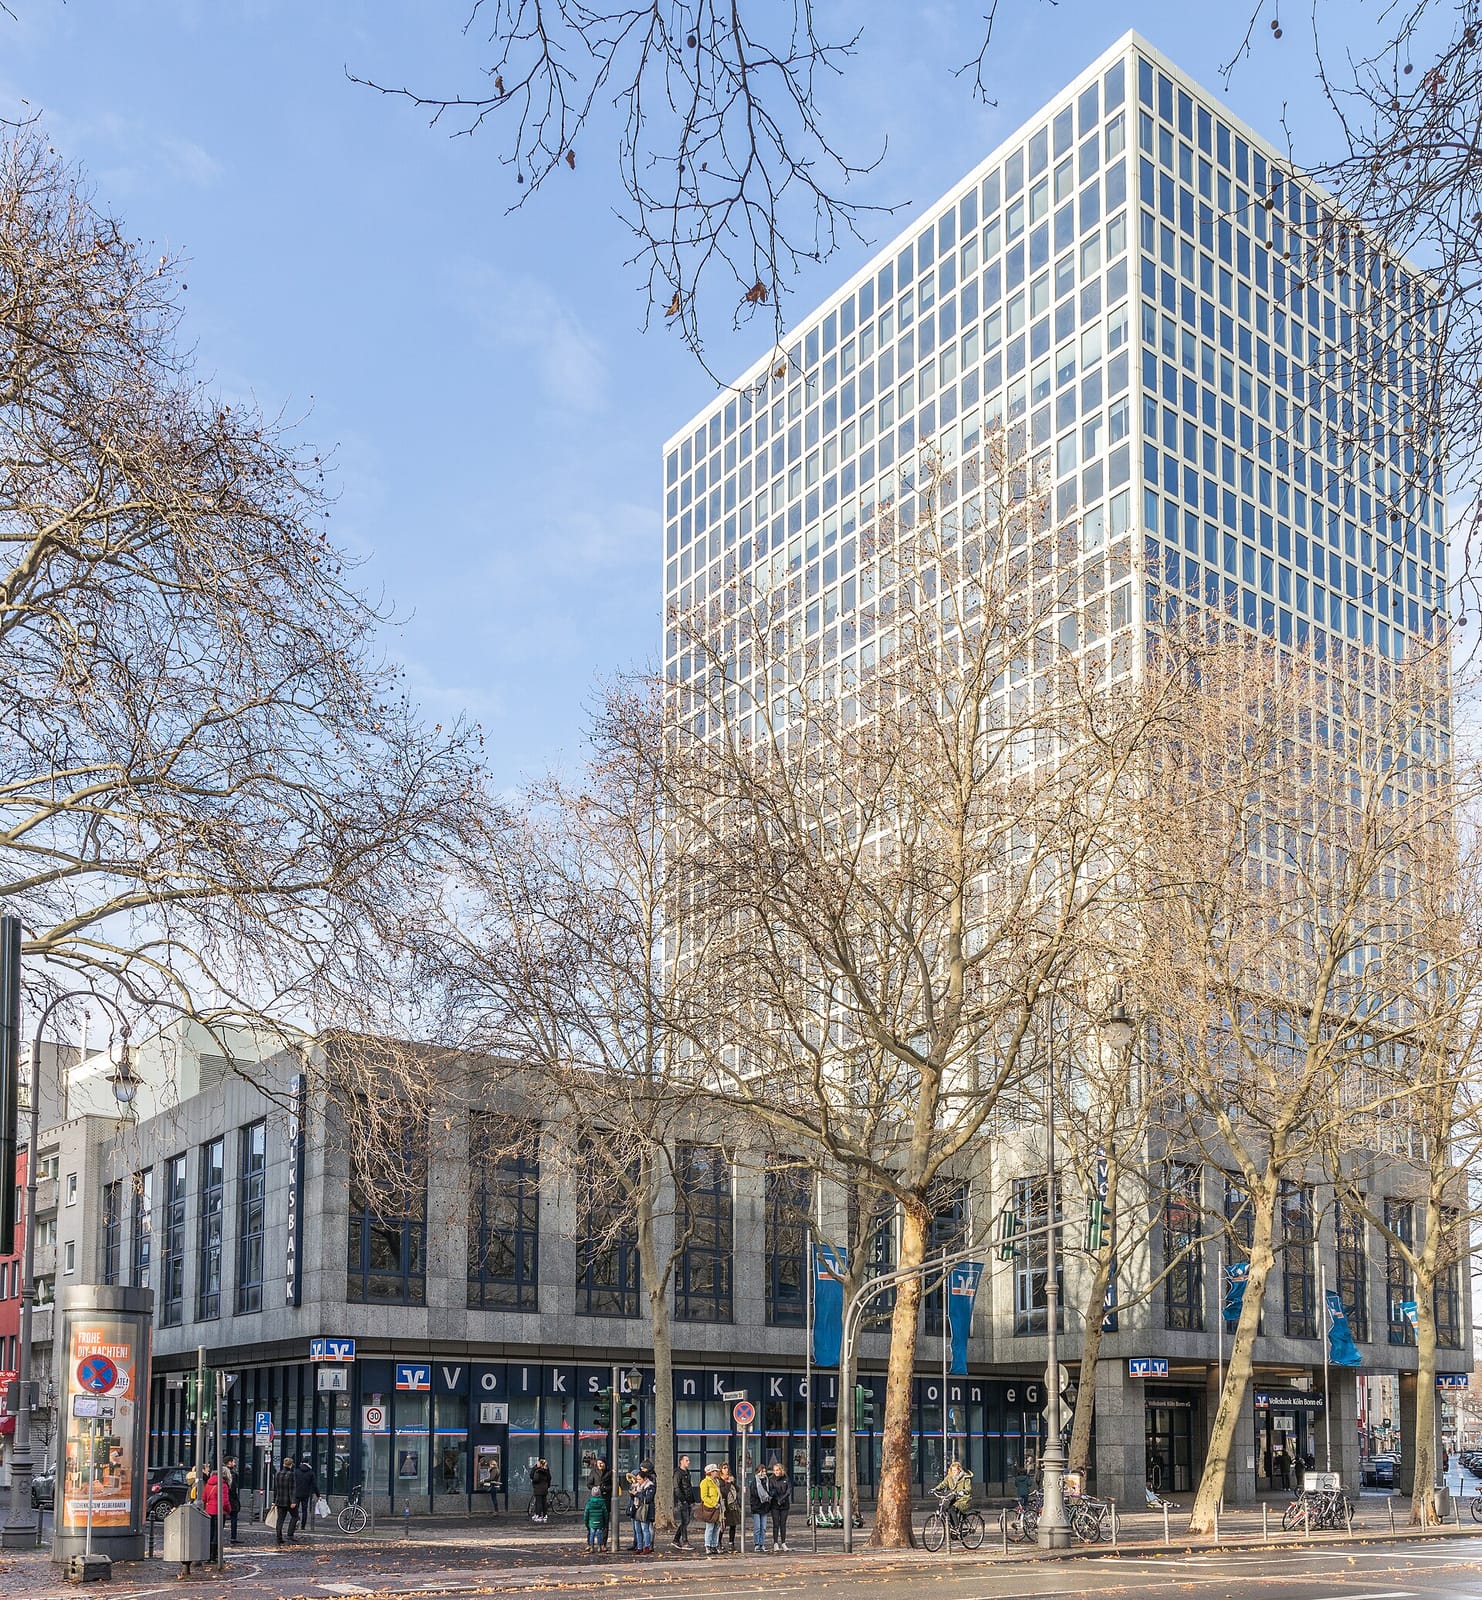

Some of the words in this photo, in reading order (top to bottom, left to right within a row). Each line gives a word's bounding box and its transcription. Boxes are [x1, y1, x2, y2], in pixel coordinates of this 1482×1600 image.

[286, 1100, 297, 1298] VOLKSBANK
[442, 1366, 725, 1396] Volksbnk
[770, 1376, 834, 1398] Köl
[927, 1386, 981, 1401] onn
[1006, 1385, 1038, 1403] eG
[1269, 1397, 1292, 1405] Volksbank
[1292, 1397, 1304, 1405] Köln
[1303, 1398, 1316, 1406] Bonn
[1316, 1398, 1323, 1406] eG
[258, 1413, 265, 1423] P
[370, 1412, 379, 1420] 30
